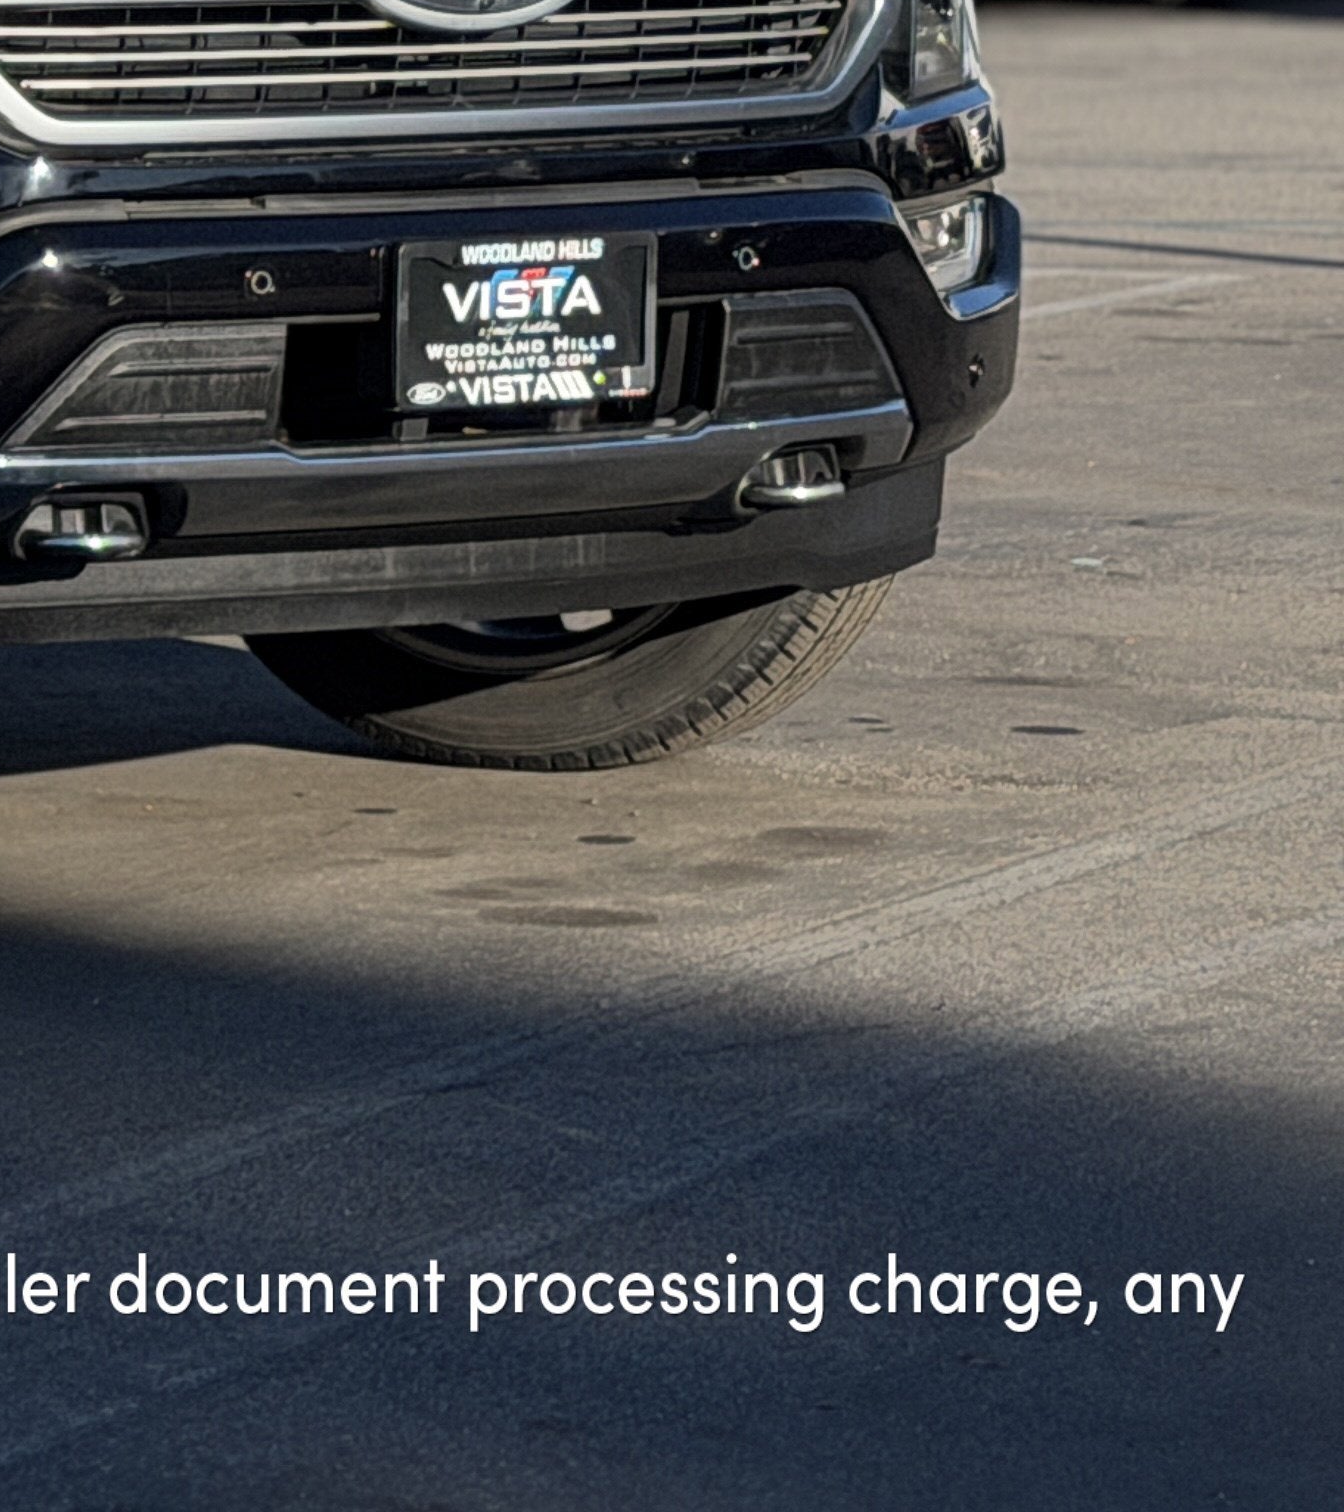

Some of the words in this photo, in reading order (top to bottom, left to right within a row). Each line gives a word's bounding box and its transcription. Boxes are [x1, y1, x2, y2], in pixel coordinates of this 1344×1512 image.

[461, 240, 555, 265] WOODLAND
[558, 238, 604, 260] HILLS
[442, 275, 602, 323] VISTA
[425, 339, 546, 360] WOODLAND
[552, 334, 616, 352] HILLS
[459, 372, 562, 406] VISTA
